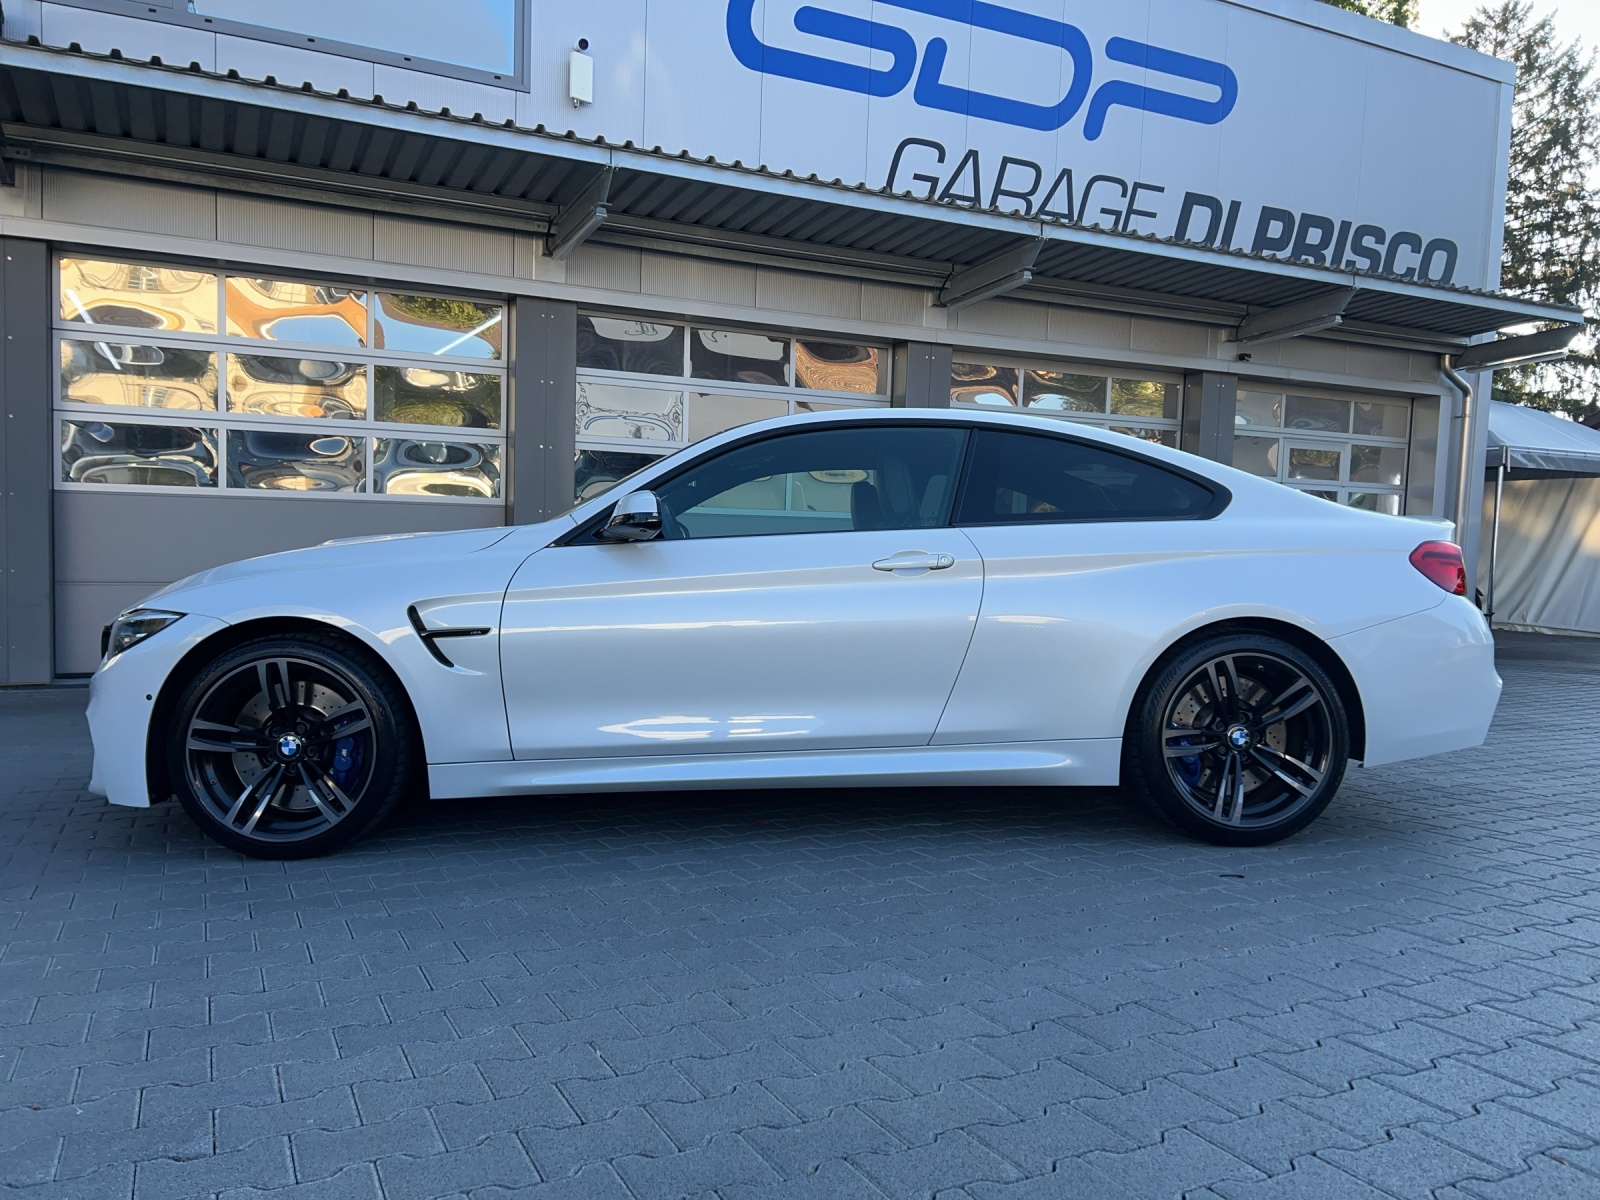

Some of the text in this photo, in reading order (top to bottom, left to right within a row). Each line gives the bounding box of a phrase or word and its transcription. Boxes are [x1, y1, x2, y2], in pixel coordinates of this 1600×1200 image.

[727, 0, 1238, 141] GDP
[886, 137, 1458, 285] GARAGE DI PRISCO
